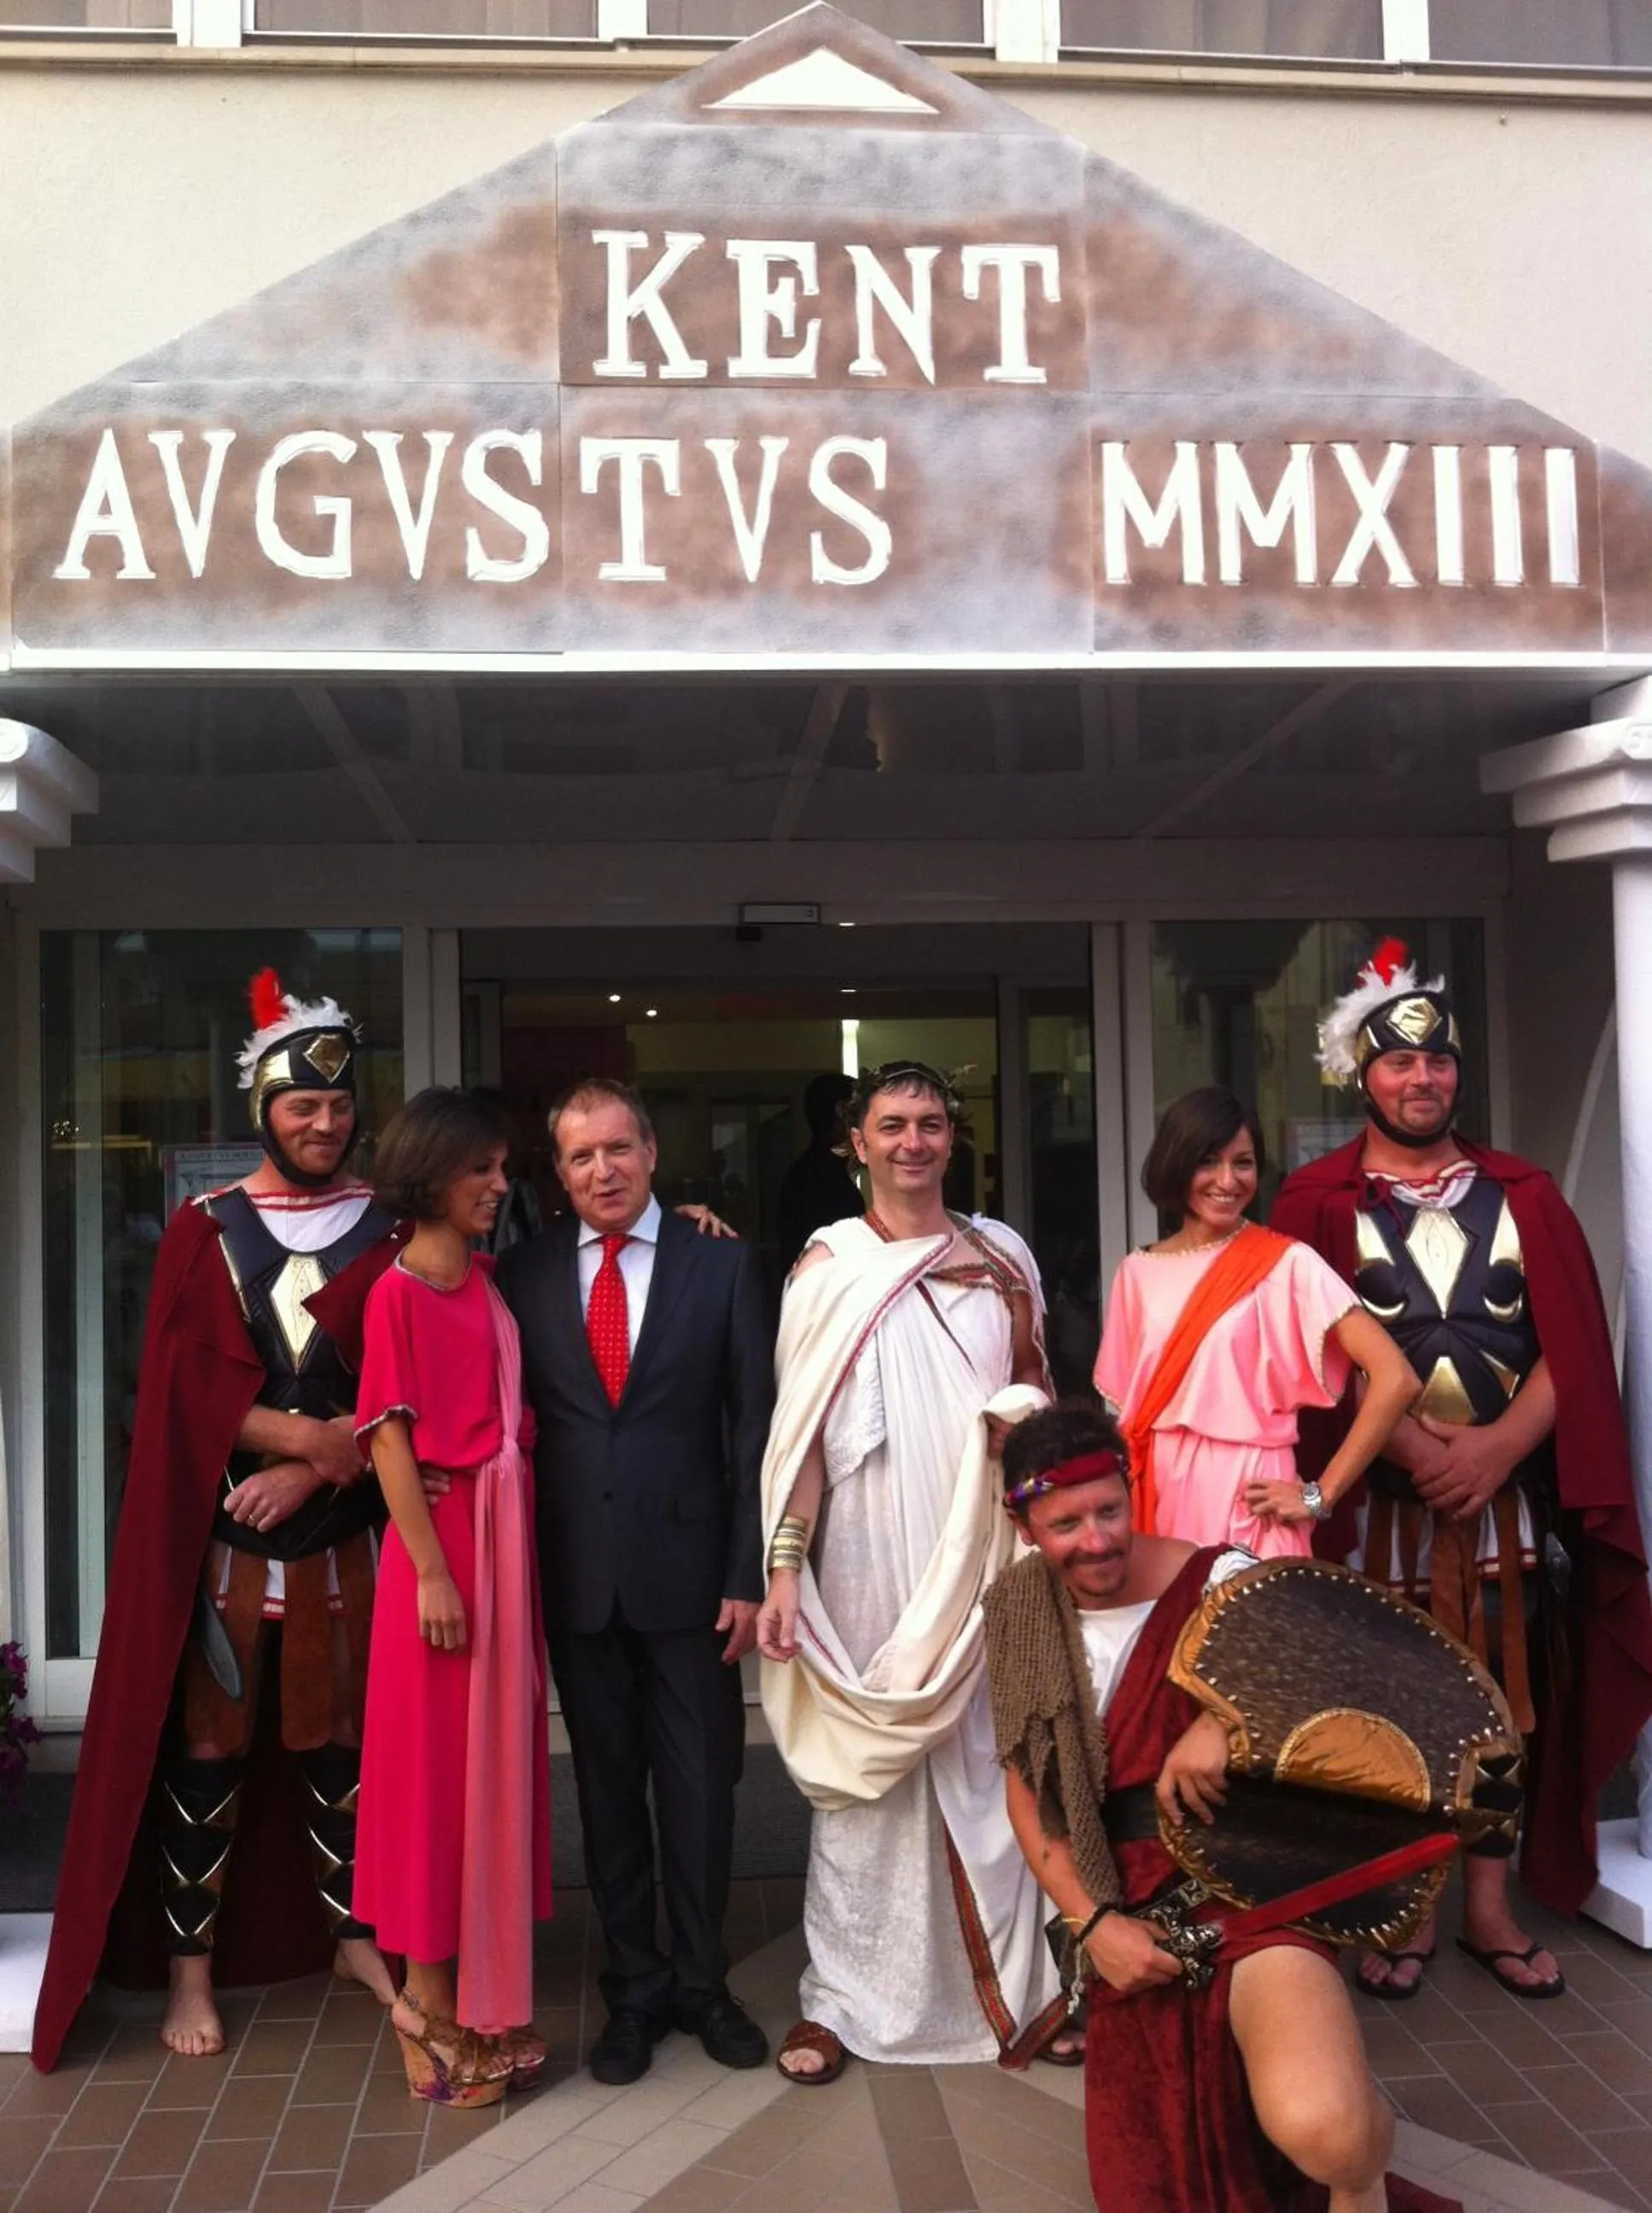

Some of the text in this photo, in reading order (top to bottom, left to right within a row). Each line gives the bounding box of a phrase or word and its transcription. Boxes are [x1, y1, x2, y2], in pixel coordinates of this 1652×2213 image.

[592, 229, 1061, 386] KENT
[52, 427, 1582, 589] AVGVSTVS MMXIII
